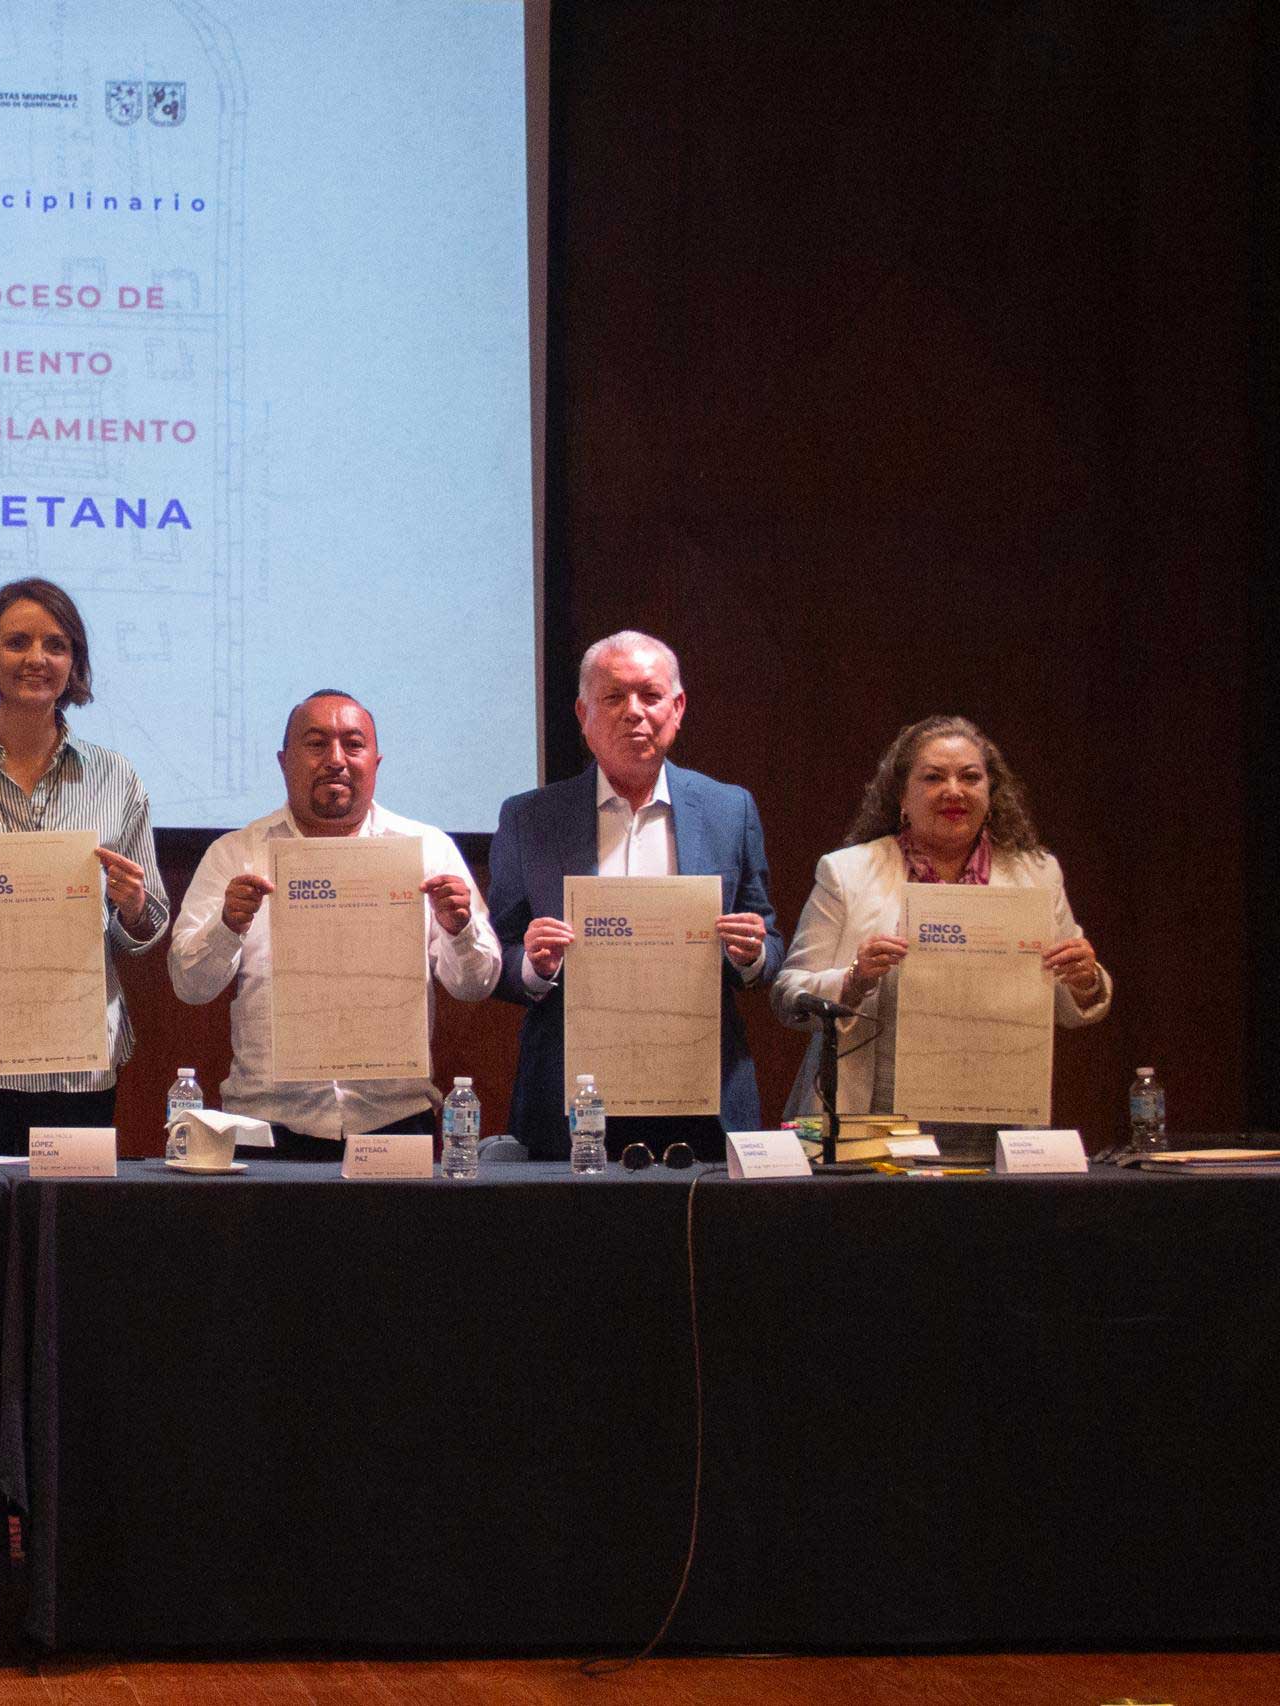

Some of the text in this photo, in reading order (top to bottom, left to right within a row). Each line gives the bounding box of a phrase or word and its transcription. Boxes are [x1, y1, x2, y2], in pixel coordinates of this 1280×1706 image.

[119, 285, 164, 309] DE
[288, 879, 331, 889] CINCO
[288, 890, 337, 900] SIGLOS
[584, 917, 627, 926] CINCO
[584, 927, 633, 937] SIGLOS
[920, 924, 961, 934] CINCO
[919, 934, 967, 944] SIGLOS
[31, 1140, 53, 1148] LÓPEZ
